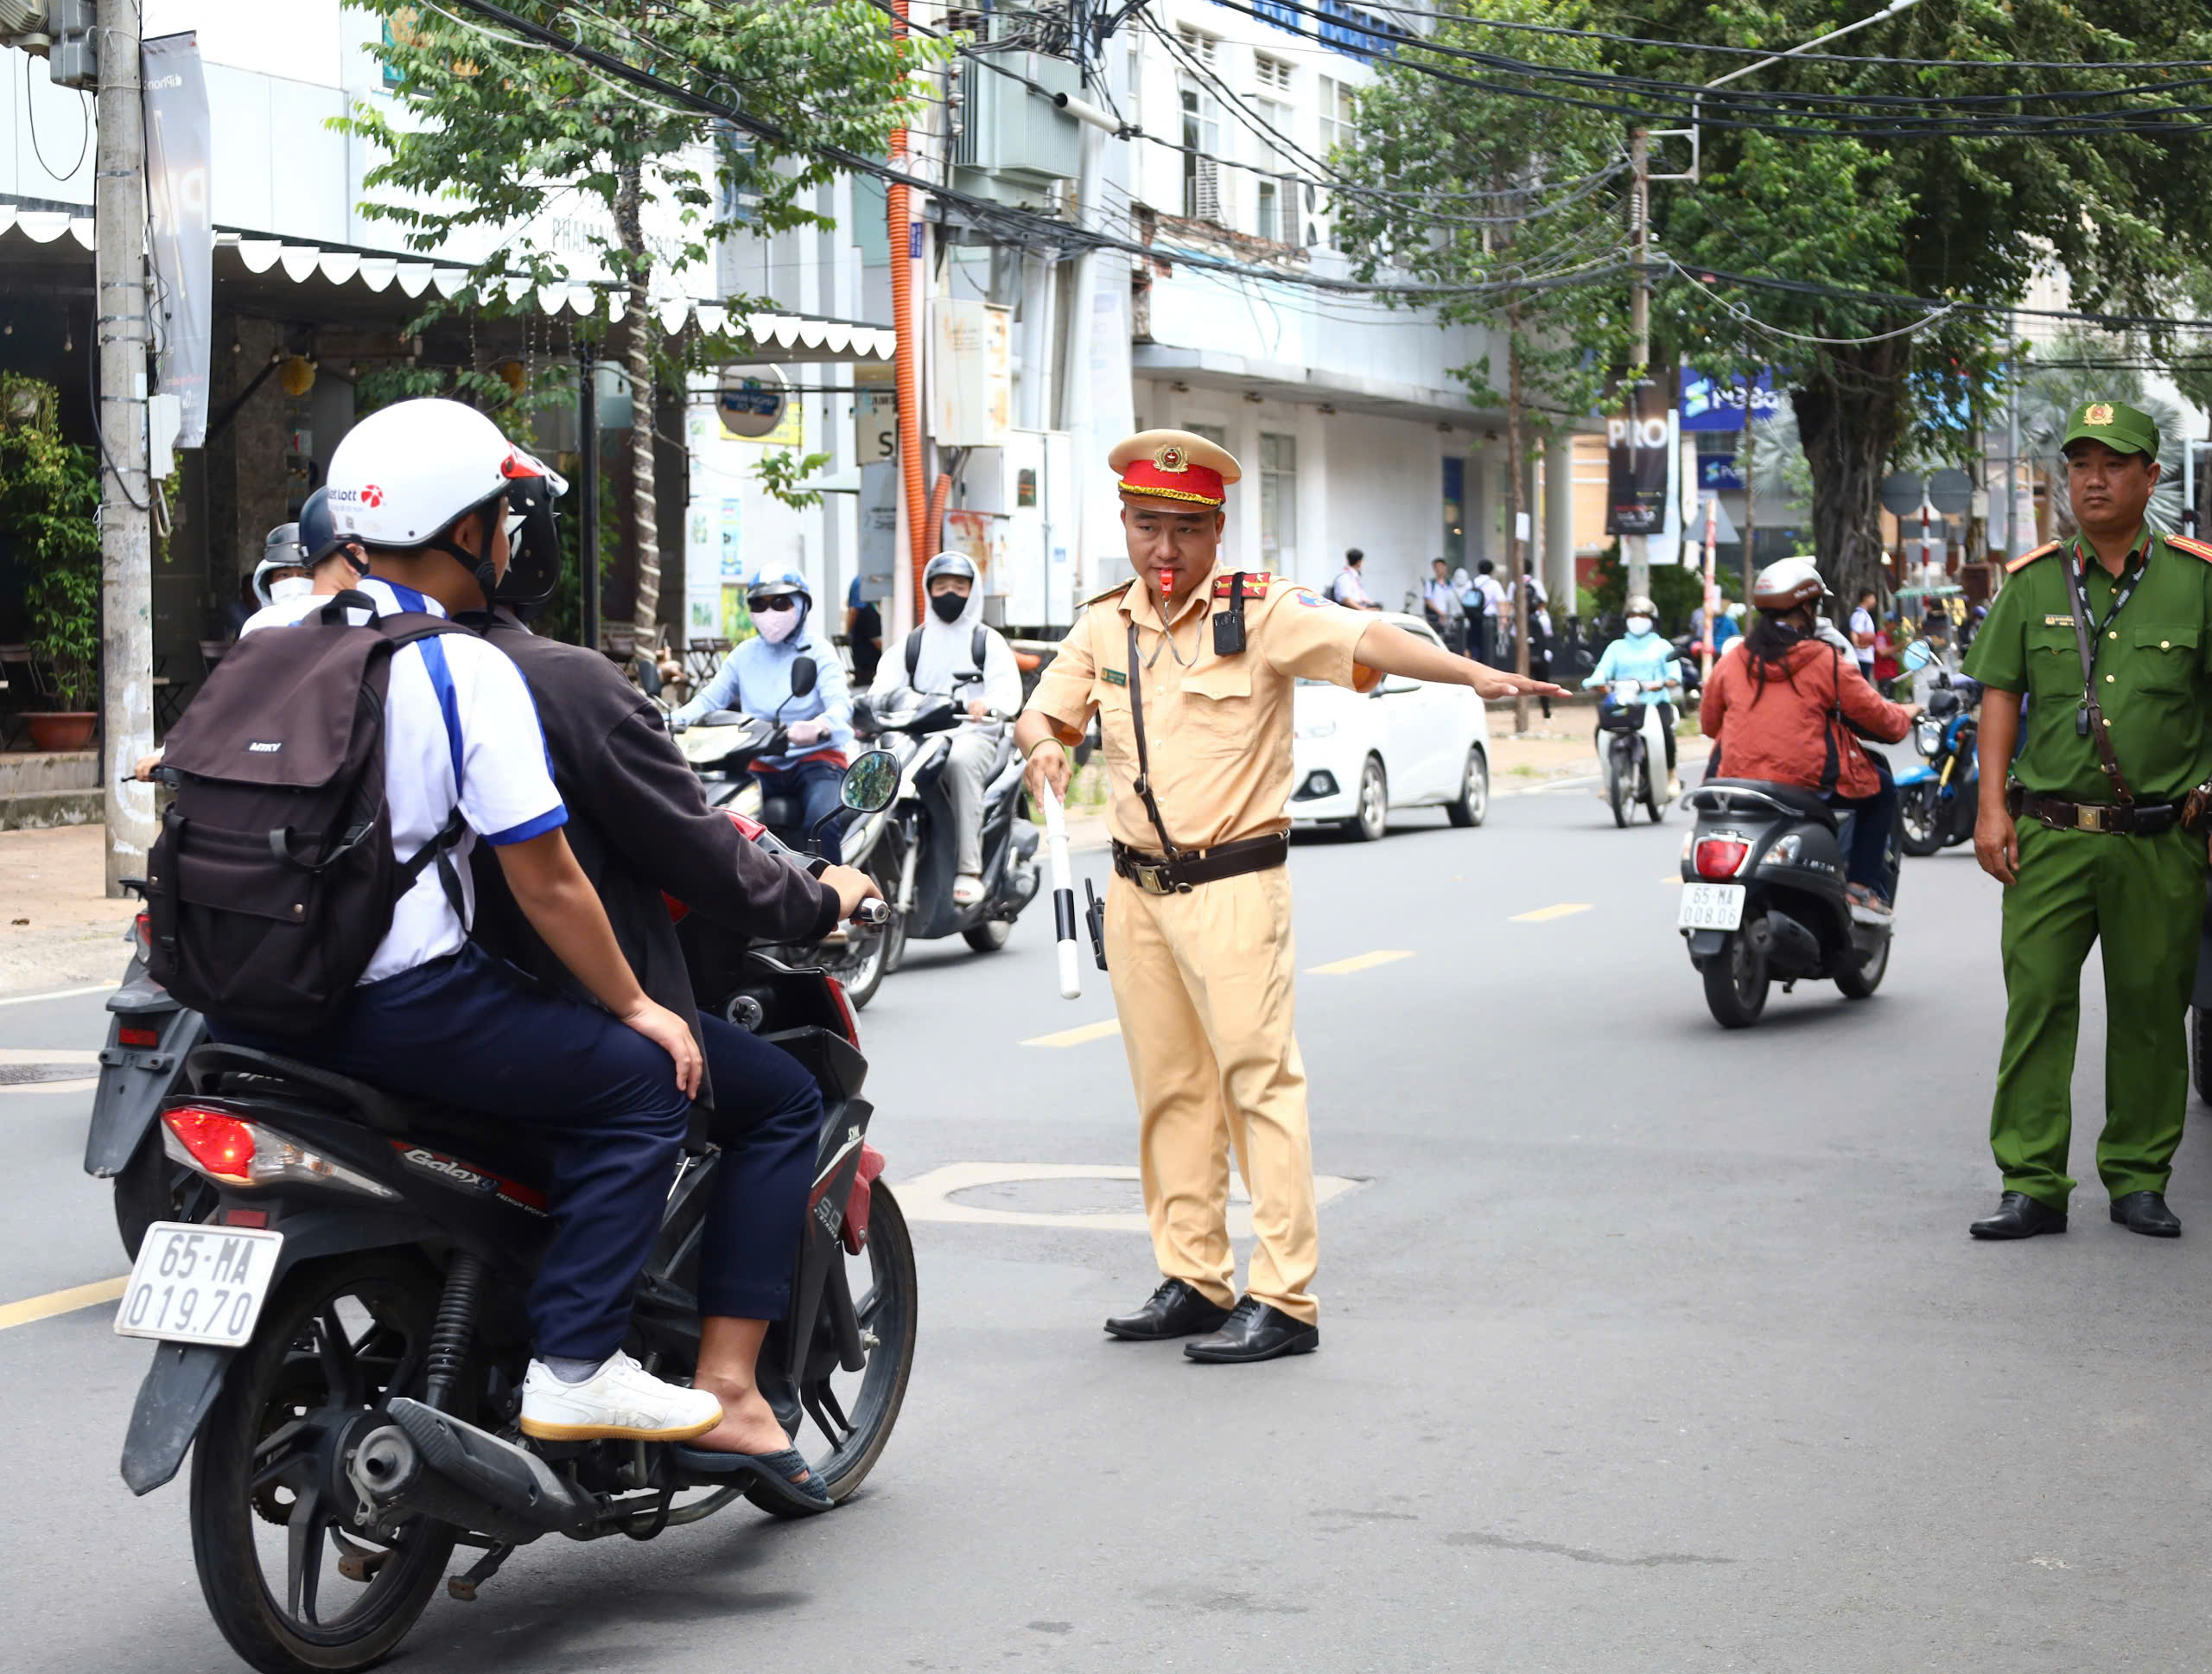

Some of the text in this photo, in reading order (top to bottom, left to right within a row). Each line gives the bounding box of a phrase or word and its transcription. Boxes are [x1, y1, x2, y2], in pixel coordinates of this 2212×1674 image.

[1607, 417, 1669, 449] PRO
[404, 1149, 499, 1192] Galaxy
[495, 1192, 524, 1209] PREMIUM
[159, 1233, 255, 1285] 65-MA
[128, 1283, 253, 1336] 019.70
